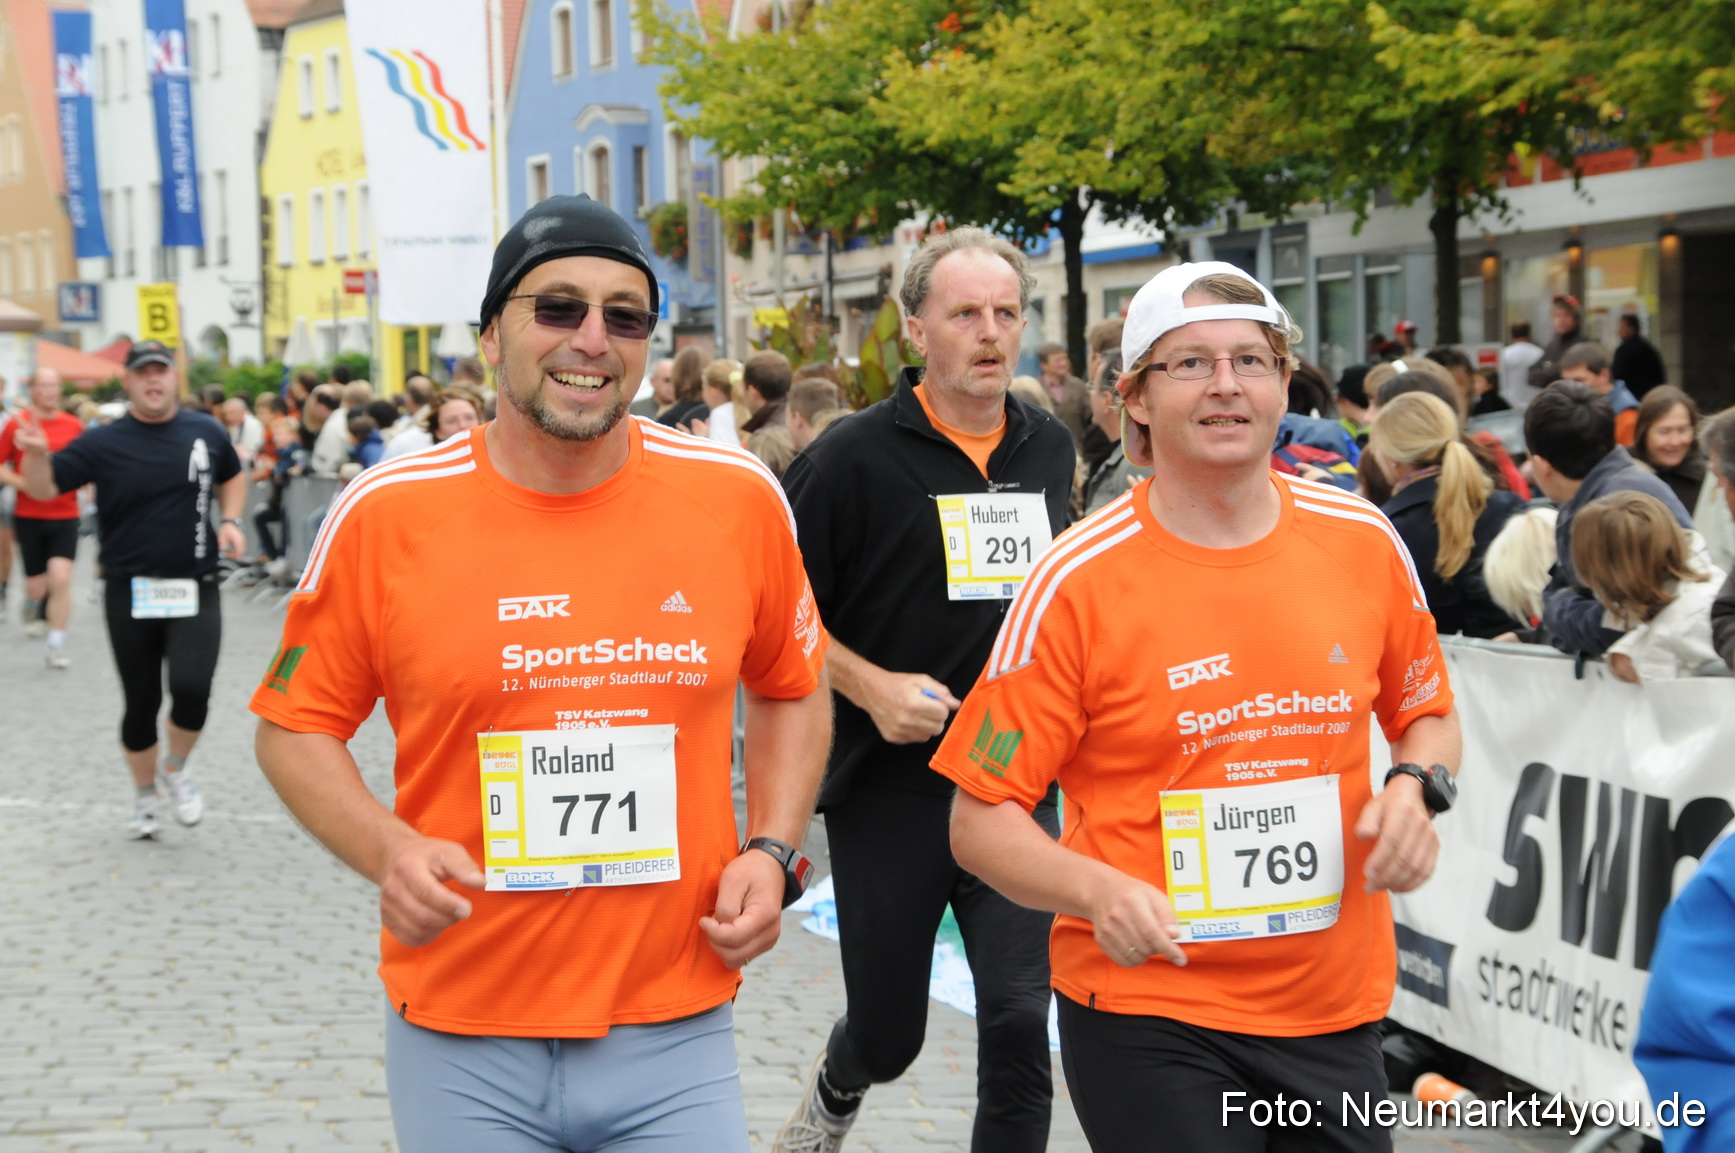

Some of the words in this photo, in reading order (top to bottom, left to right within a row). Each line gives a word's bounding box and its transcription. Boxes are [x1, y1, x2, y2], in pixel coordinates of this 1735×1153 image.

[149, 304, 168, 331] B
[971, 505, 1019, 524] Hubert
[949, 536, 957, 550] D
[985, 536, 1031, 564] 291
[498, 594, 571, 621] DAK
[661, 603, 692, 613] adidas
[502, 637, 707, 673] SportScheck
[501, 678, 524, 692] 12.
[529, 673, 605, 690] Nürnberger
[609, 670, 673, 686] Stadtlauf
[676, 671, 707, 686] 2007
[1167, 653, 1233, 690] DAK
[555, 710, 583, 720] TSV
[583, 708, 649, 720] Katzwang
[1177, 689, 1352, 735] SportScheck
[555, 720, 587, 730] 1905
[587, 719, 611, 729] e.V.
[1271, 722, 1325, 737] Stadtlauf
[1327, 721, 1351, 735] 2007
[532, 743, 614, 775] Roland
[1225, 762, 1250, 772] TSV
[1251, 758, 1309, 770] Katzwang
[1225, 770, 1254, 781] 1905
[1255, 769, 1277, 779] e.V.
[490, 794, 501, 816] D
[552, 790, 637, 836] 771
[1214, 803, 1296, 833] Jürgen
[605, 858, 676, 876] PFLEIDERER
[1173, 850, 1184, 870] D
[1235, 841, 1318, 888] 769
[505, 871, 555, 883] BOCK
[1191, 922, 1241, 935] BOCK
[1478, 951, 1628, 1053] stadtwerke
